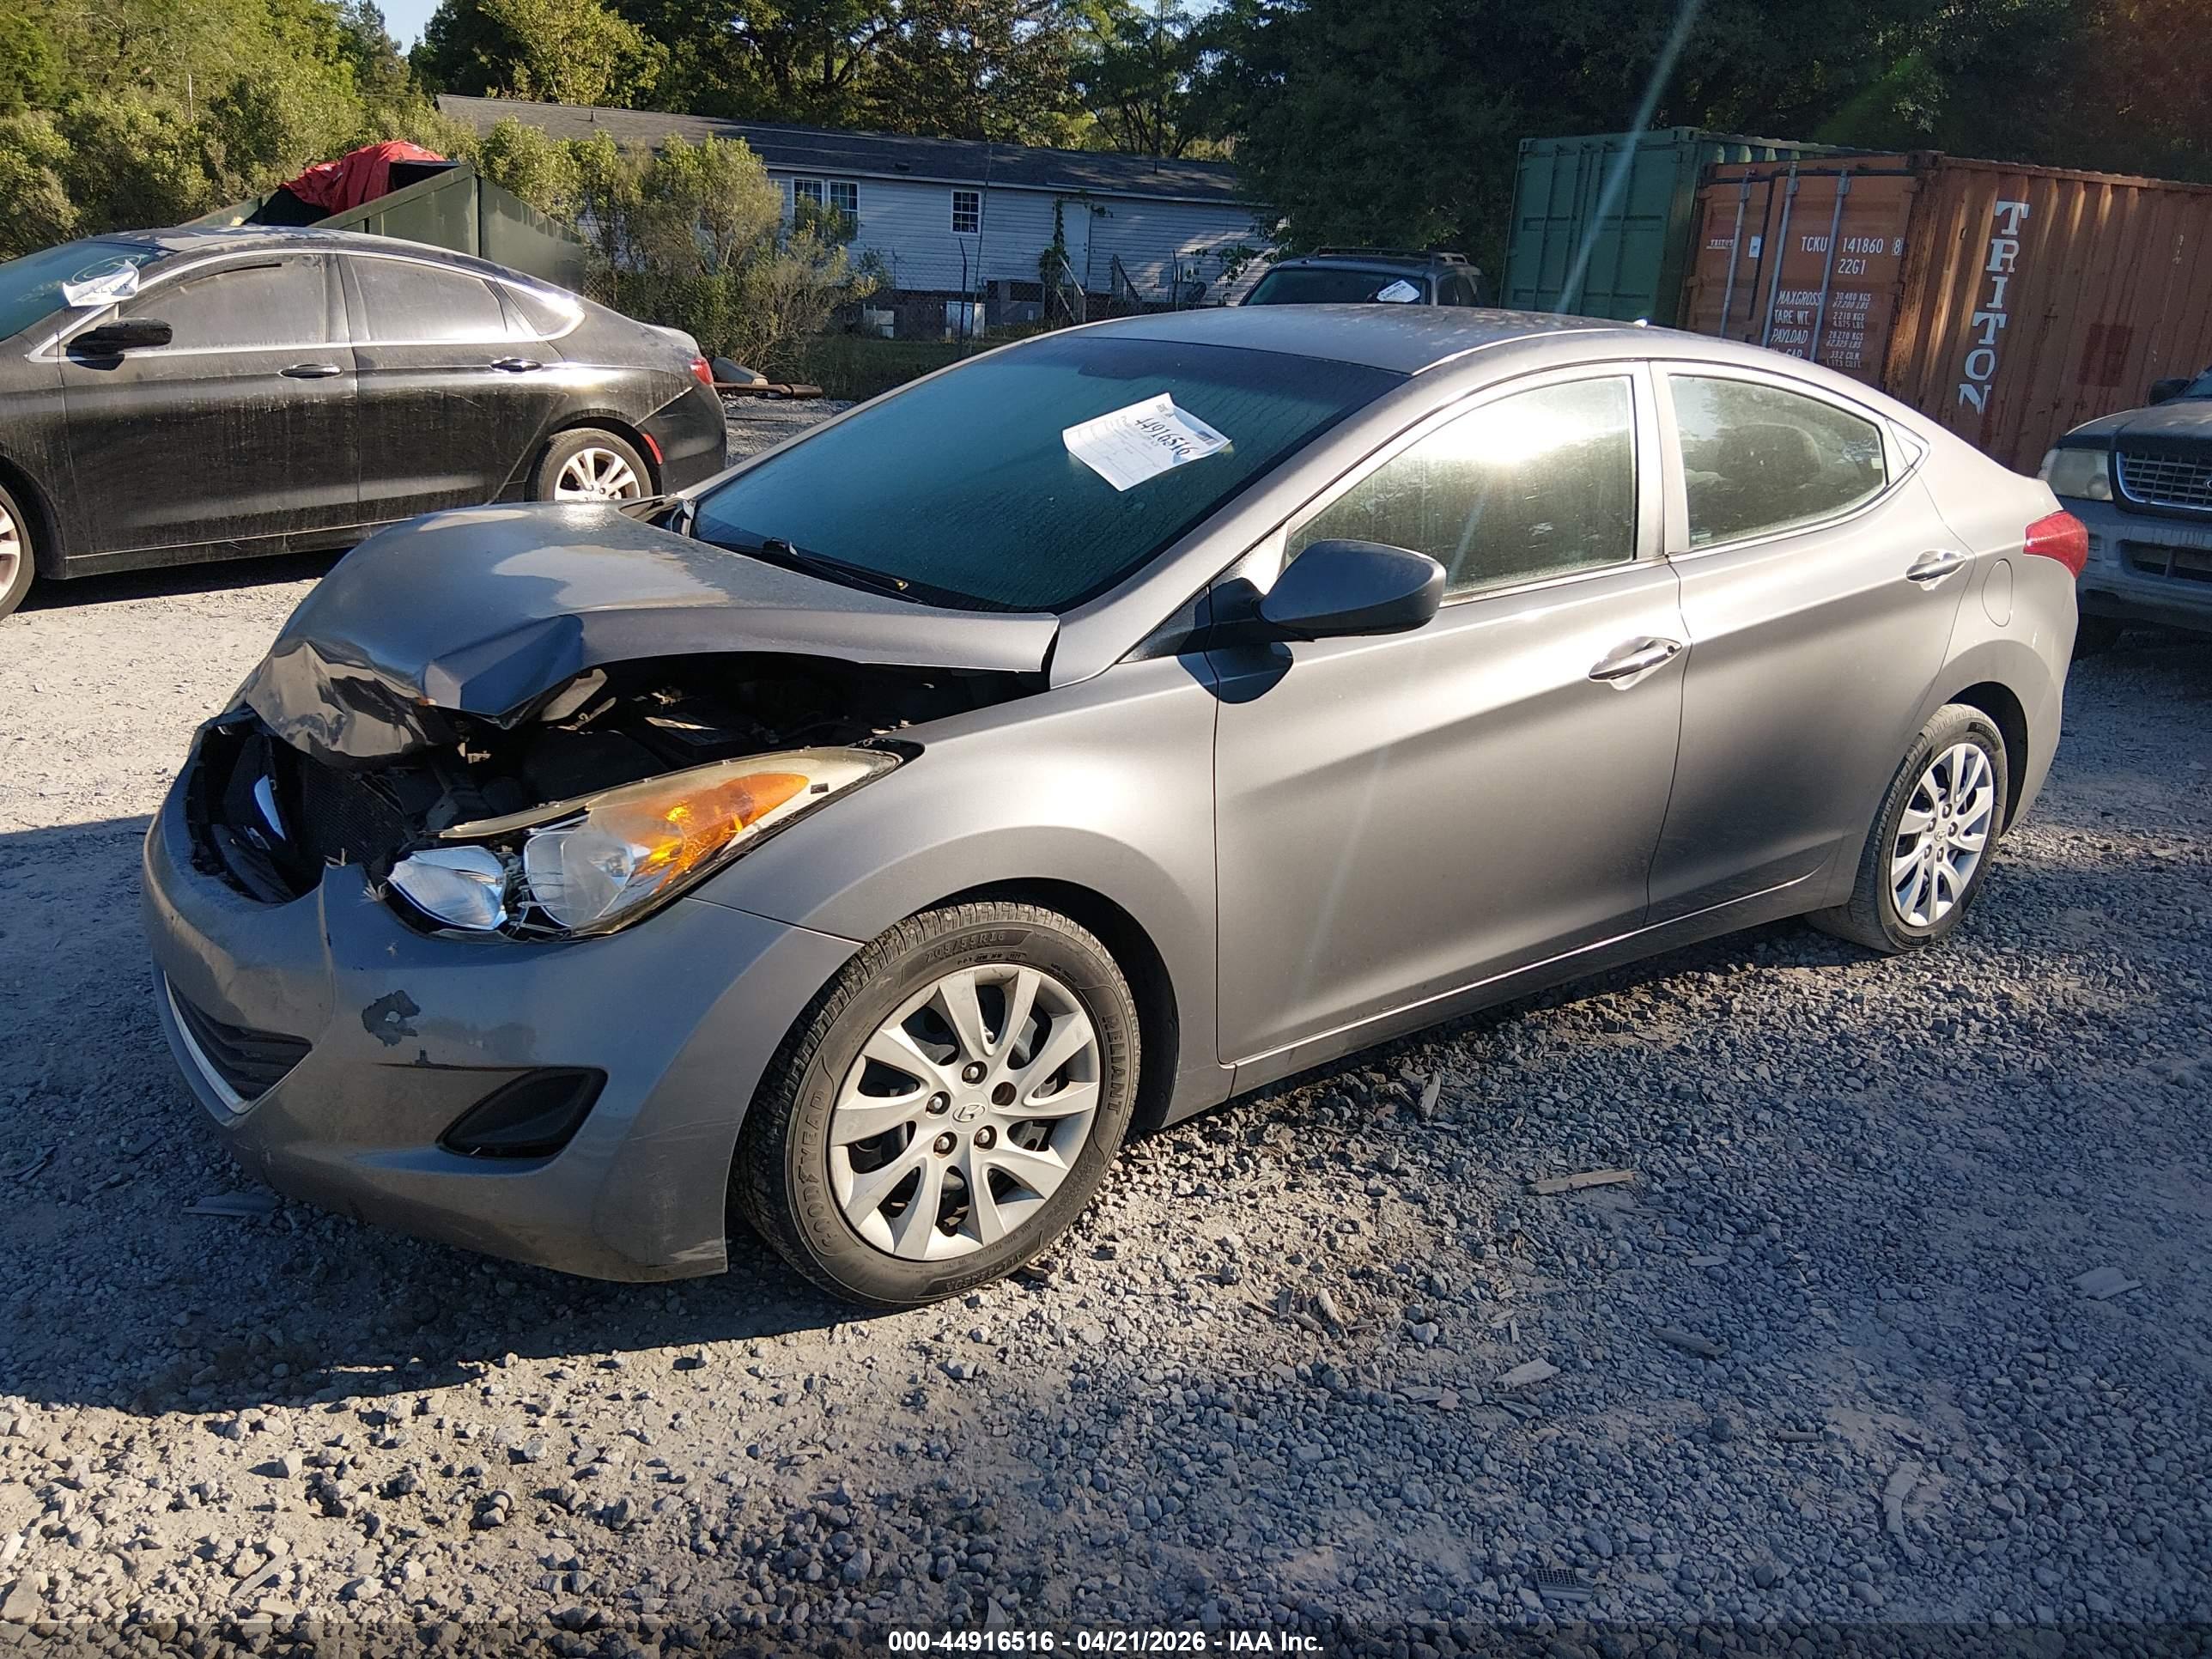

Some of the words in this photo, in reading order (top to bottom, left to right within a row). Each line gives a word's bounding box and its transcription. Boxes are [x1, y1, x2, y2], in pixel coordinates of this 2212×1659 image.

[1802, 236, 1828, 252] TCKU
[1842, 237, 1884, 254] 141860
[1893, 239, 1903, 255] 8
[1838, 258, 1867, 275] 22G1
[1858, 293, 1872, 302] KGS
[1959, 201, 2030, 414] TRITON
[1774, 309, 1794, 325] TARE
[1771, 328, 1808, 344] PAYLOAD
[1101, 1014, 1127, 1115] RELIANT
